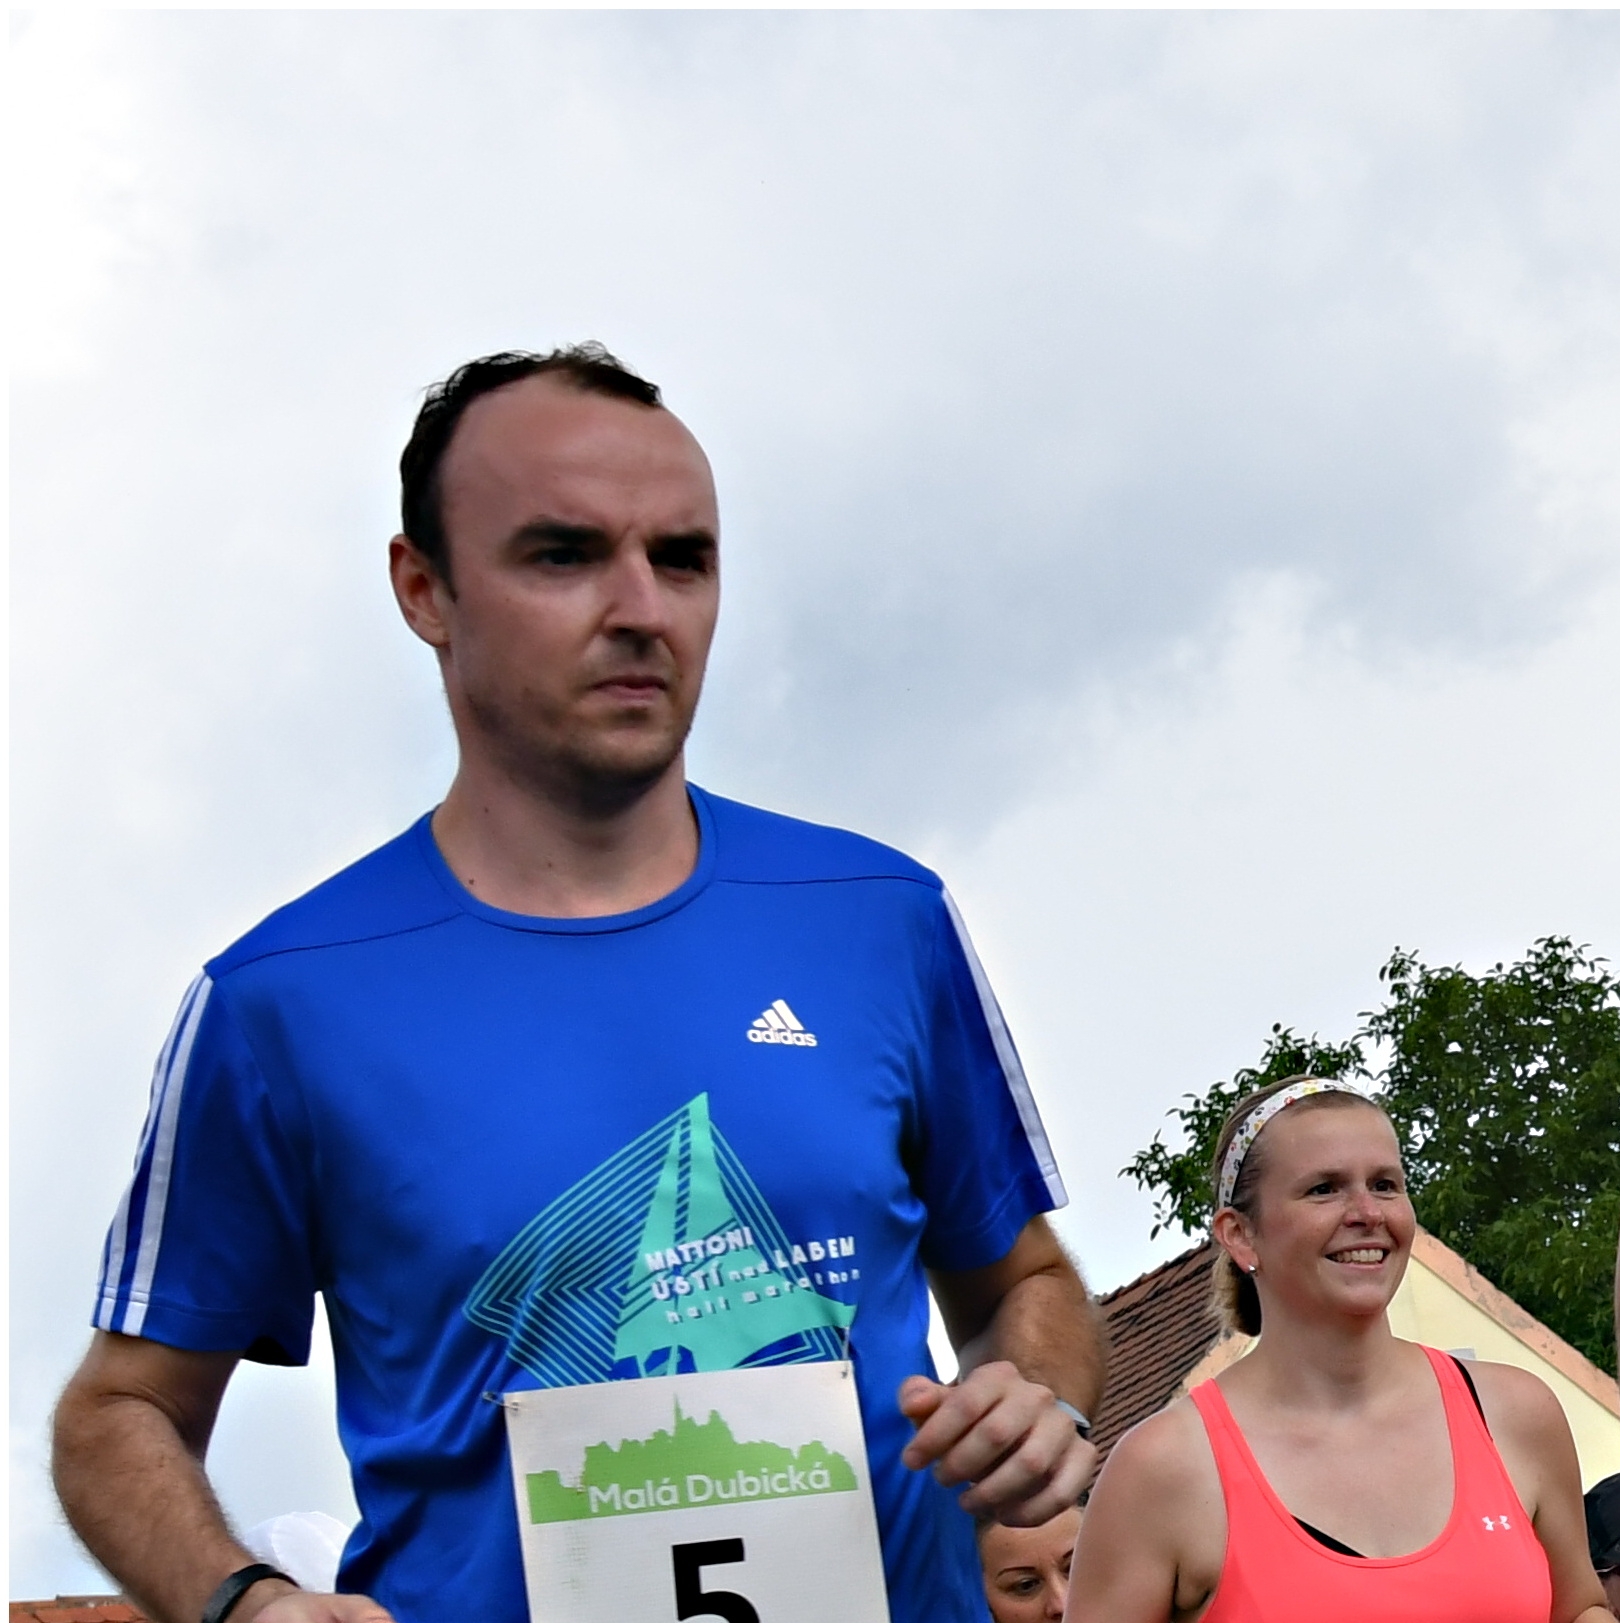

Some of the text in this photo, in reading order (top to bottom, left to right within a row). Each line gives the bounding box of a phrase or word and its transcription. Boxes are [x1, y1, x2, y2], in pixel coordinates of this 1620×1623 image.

[747, 1028, 817, 1047] adidas
[645, 1226, 755, 1272] MATTONI
[729, 1259, 769, 1282] nad
[774, 1236, 855, 1268] LABEM
[588, 1462, 831, 1513] Malá Dubická
